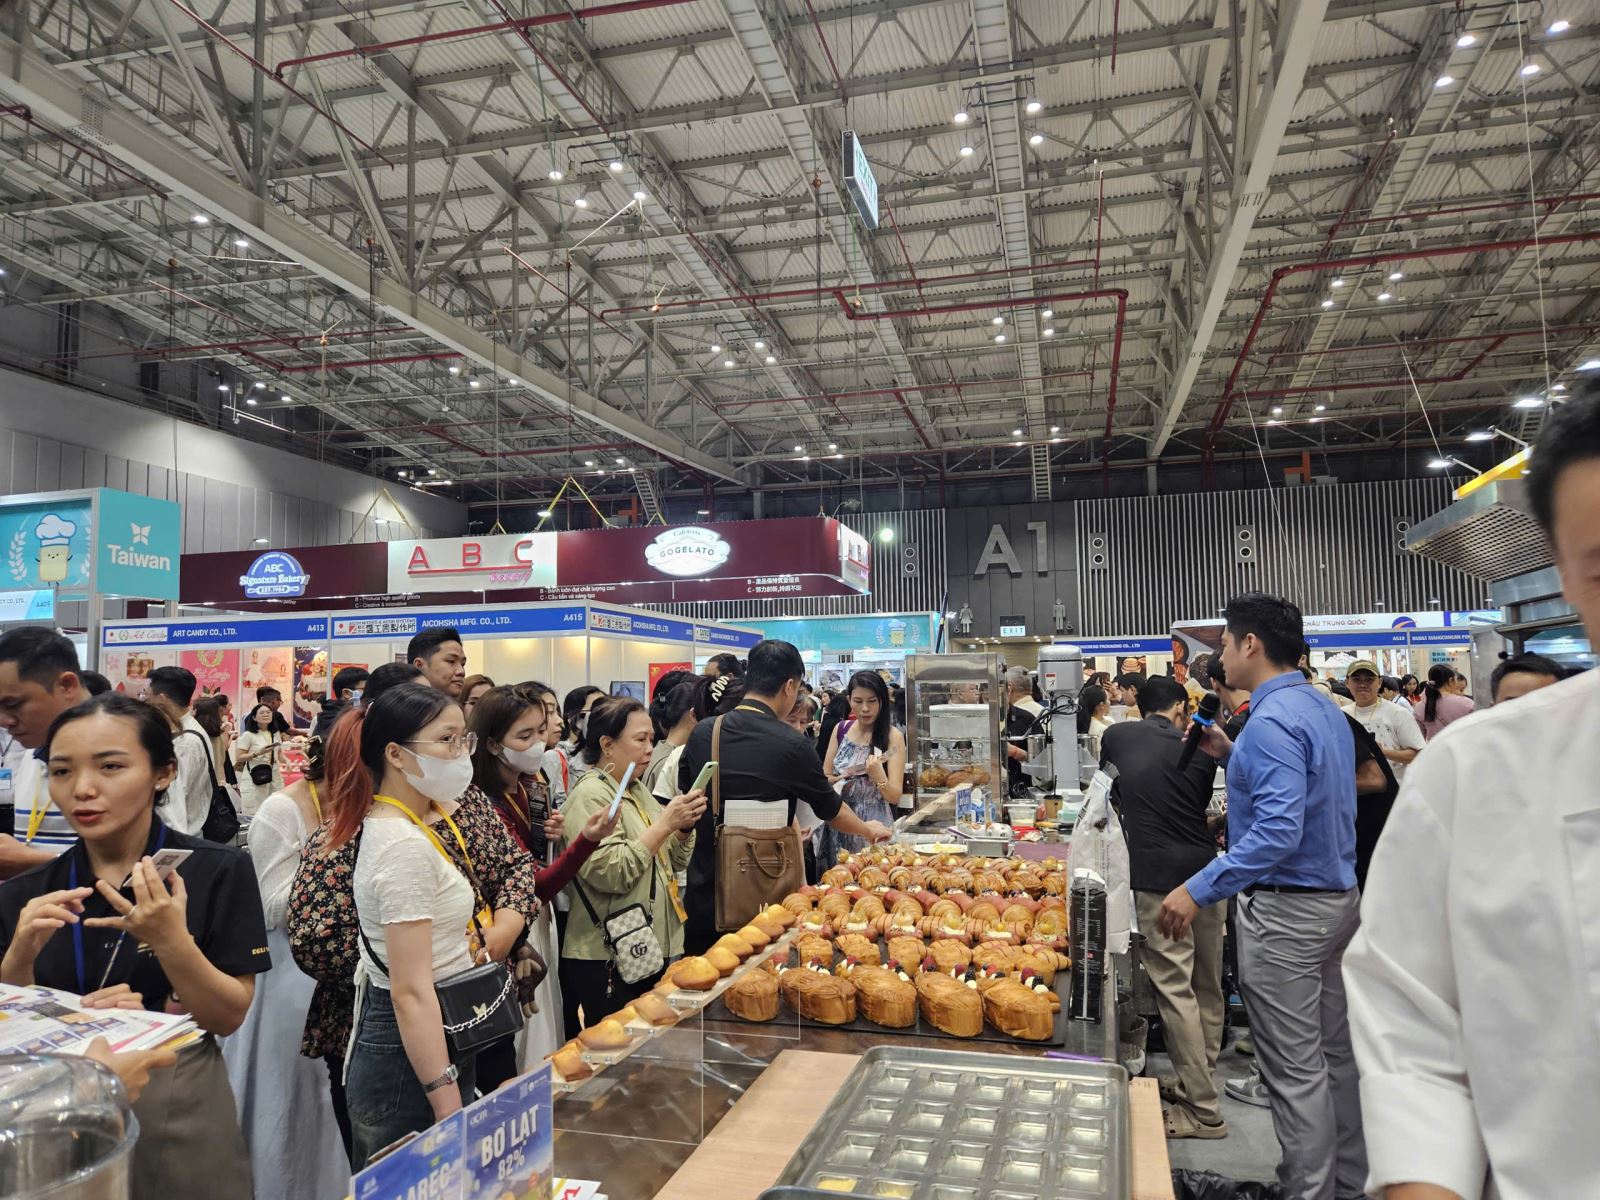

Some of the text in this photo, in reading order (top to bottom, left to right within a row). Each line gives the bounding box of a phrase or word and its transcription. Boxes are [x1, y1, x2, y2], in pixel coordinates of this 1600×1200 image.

[660, 546, 715, 558] GOGELATO
[974, 521, 1048, 575] A1
[107, 544, 170, 572] Taiwan
[264, 563, 284, 573] ABC
[422, 616, 513, 628] AICOHSHA MFG. CO., LTD.
[563, 613, 583, 622] A415
[186, 629, 208, 637] CANDY
[209, 628, 222, 637] CO.,
[223, 627, 238, 636] LTD.
[307, 624, 325, 632] A413
[511, 1103, 539, 1148] LẠT
[498, 1145, 525, 1180] 82%
